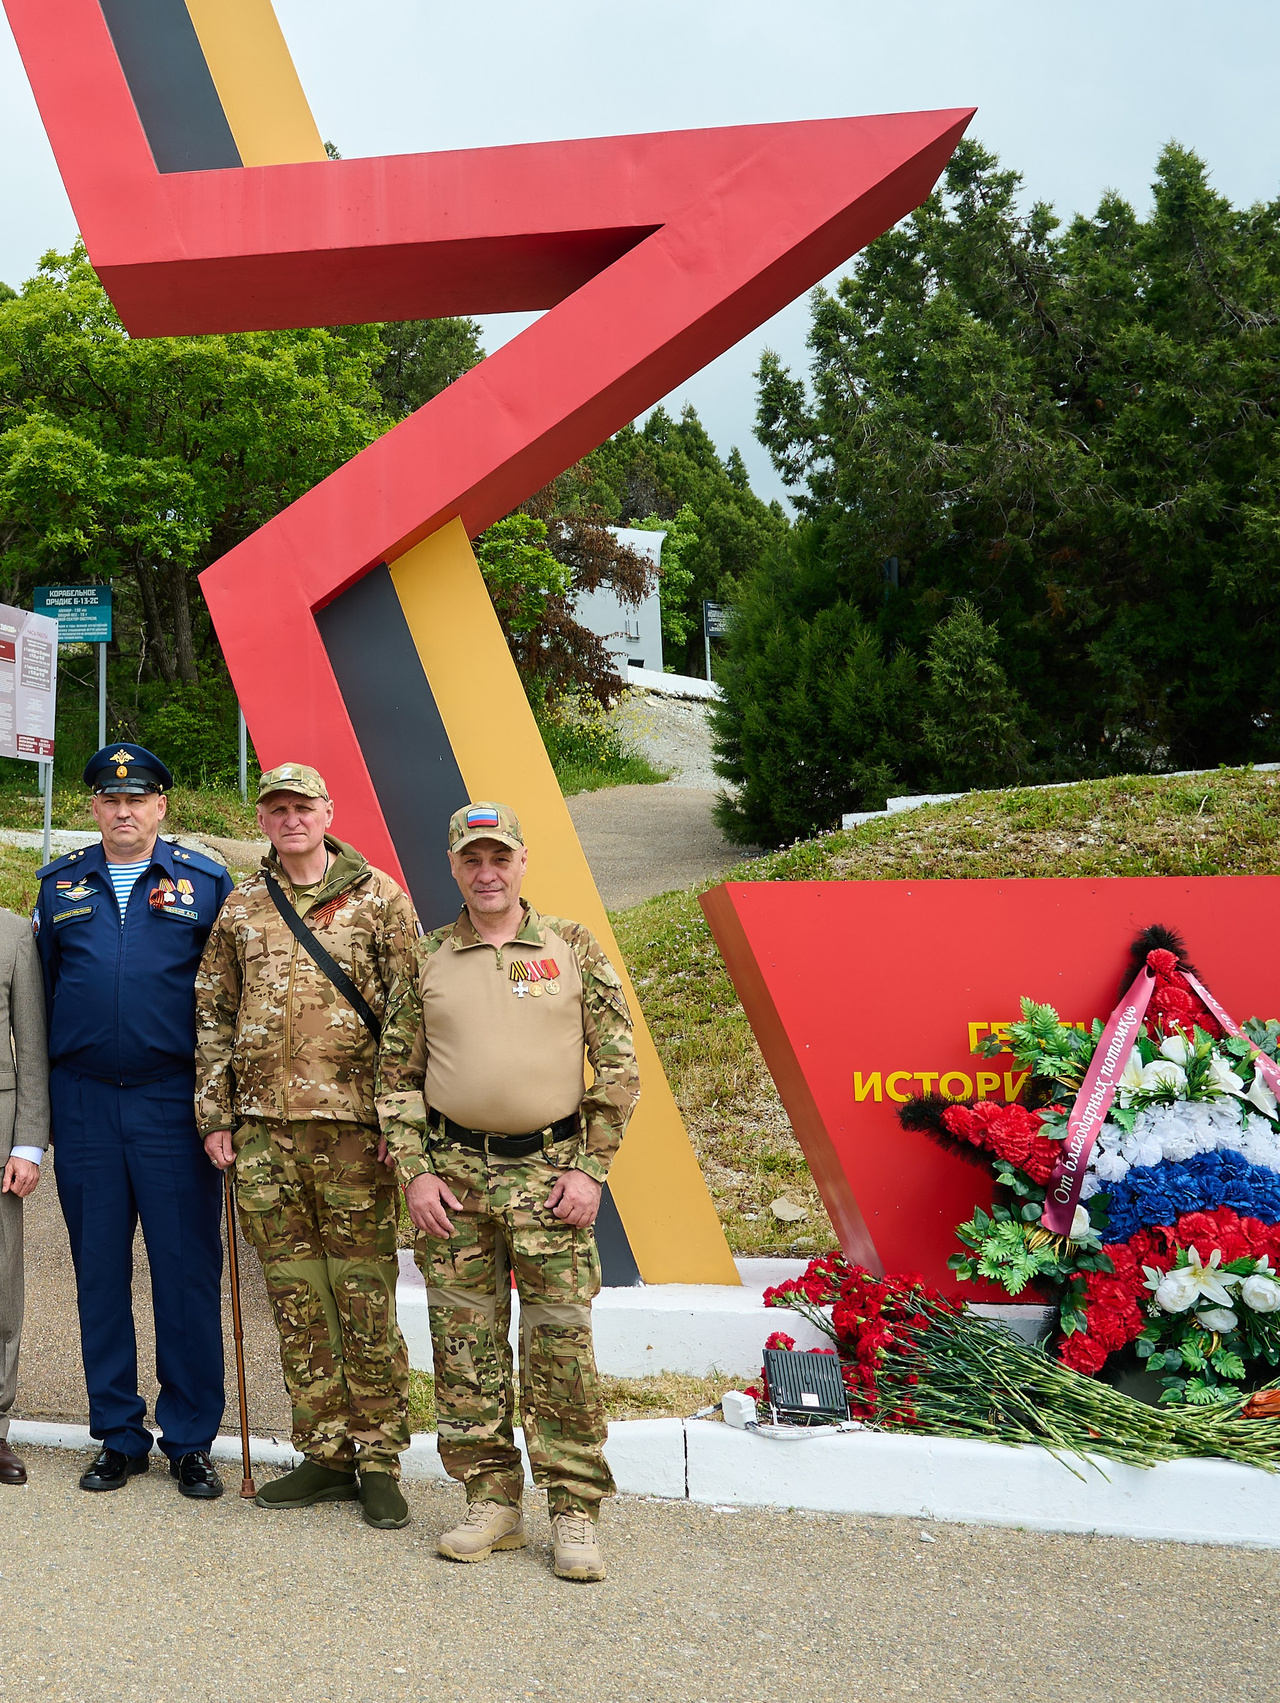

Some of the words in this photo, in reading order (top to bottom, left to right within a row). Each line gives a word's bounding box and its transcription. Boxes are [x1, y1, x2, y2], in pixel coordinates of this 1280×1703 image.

[49, 589, 96, 597] КОРАБЕЛЬНОЕ
[46, 598, 72, 606] ОРУДИЕ
[280, 767, 293, 780] Z
[1053, 1174, 1074, 1204] От
[1099, 1005, 1138, 1083] потомков
